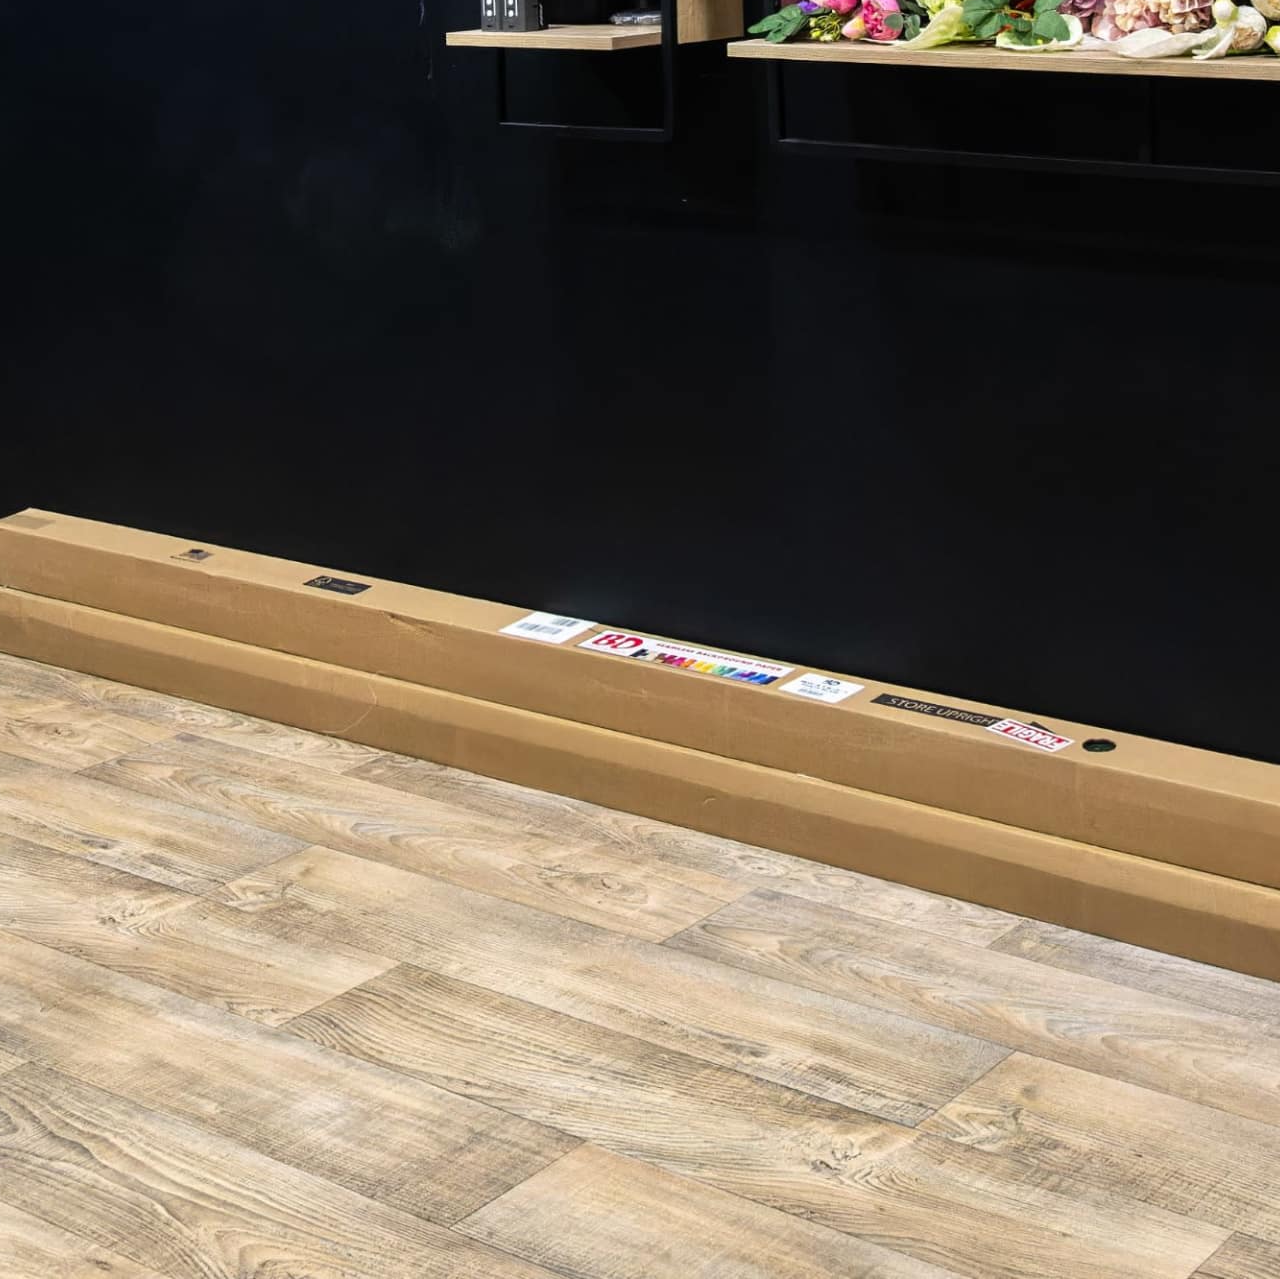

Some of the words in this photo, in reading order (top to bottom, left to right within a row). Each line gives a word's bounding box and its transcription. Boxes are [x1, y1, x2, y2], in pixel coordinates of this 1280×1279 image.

[591, 633, 644, 649] BD
[755, 662, 783, 672] PAPER
[888, 696, 935, 713] STORE
[936, 706, 995, 724] UPRIGH
[992, 720, 1068, 749] FRAGILE
